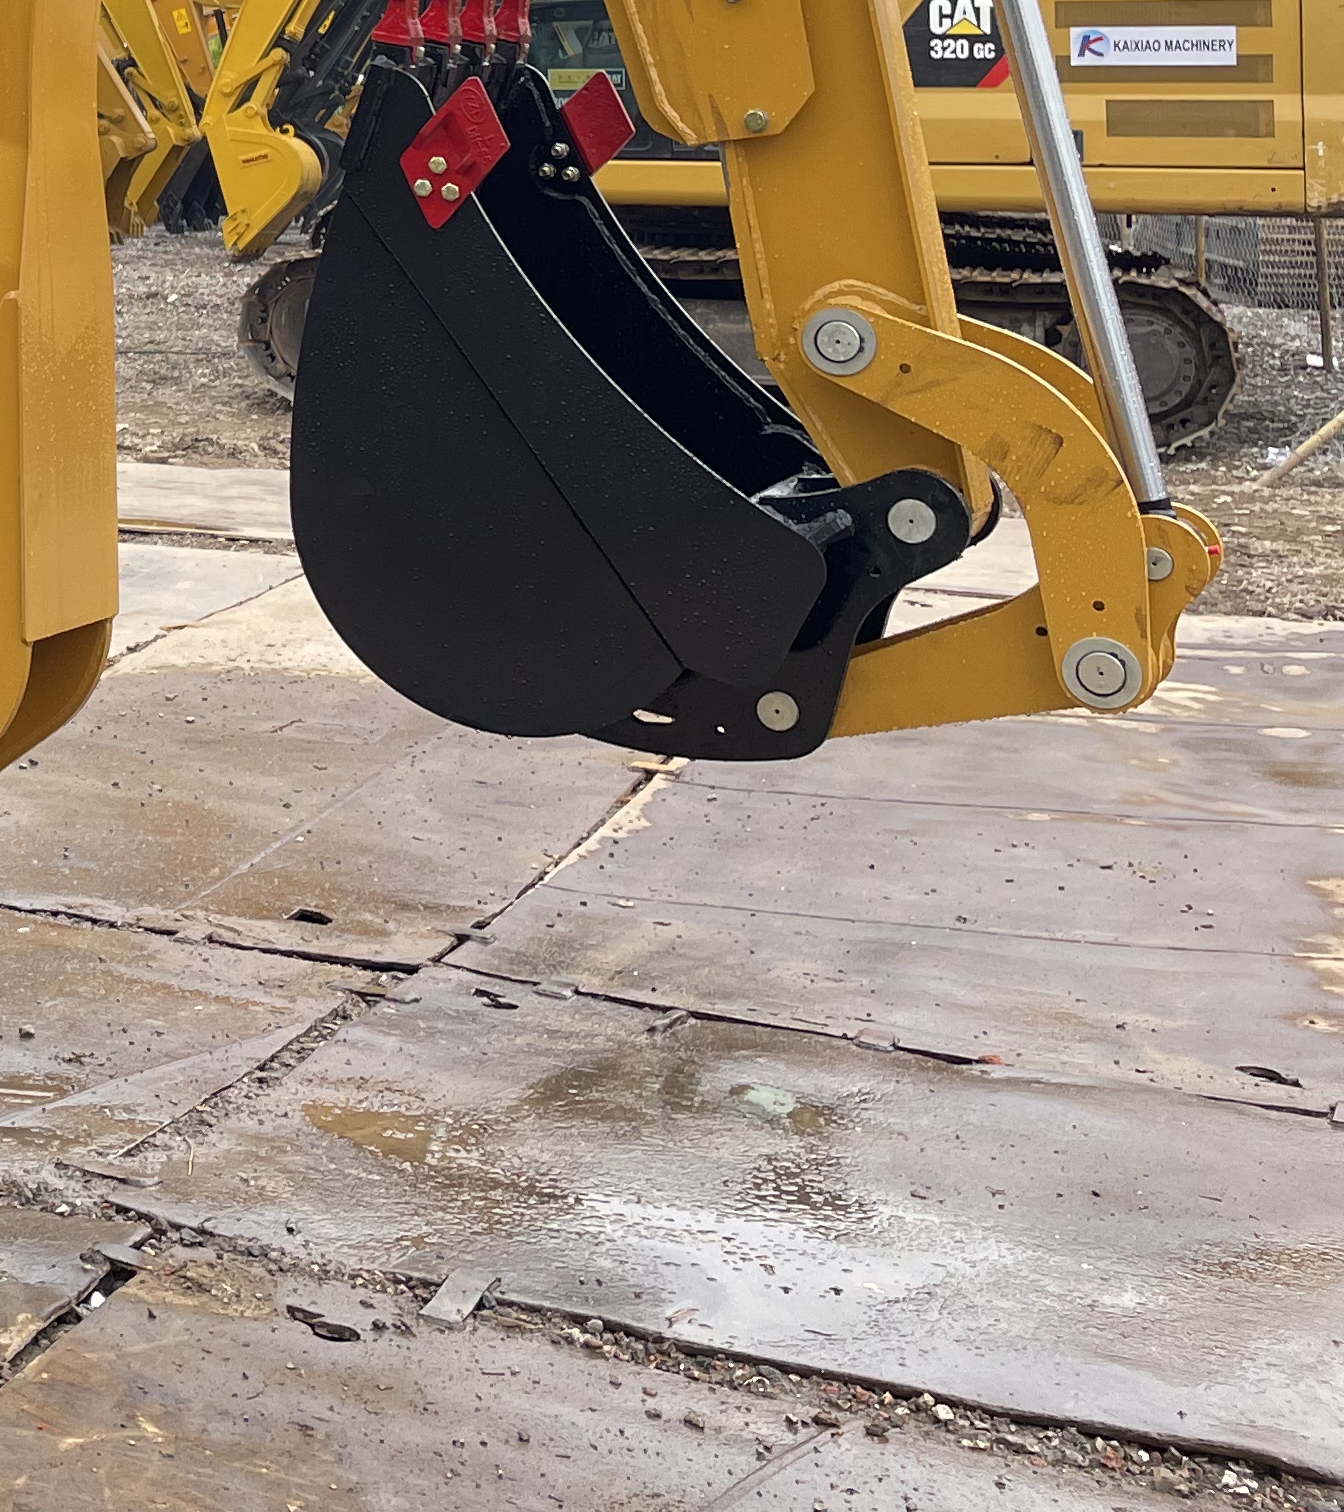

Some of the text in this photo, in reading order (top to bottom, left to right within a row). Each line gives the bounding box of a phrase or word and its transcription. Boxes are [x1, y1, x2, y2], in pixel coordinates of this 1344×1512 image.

[929, 38, 996, 60] 320 GC
[1113, 39, 1161, 52] KAIXIAO
[1164, 39, 1235, 52] MACHINERY
